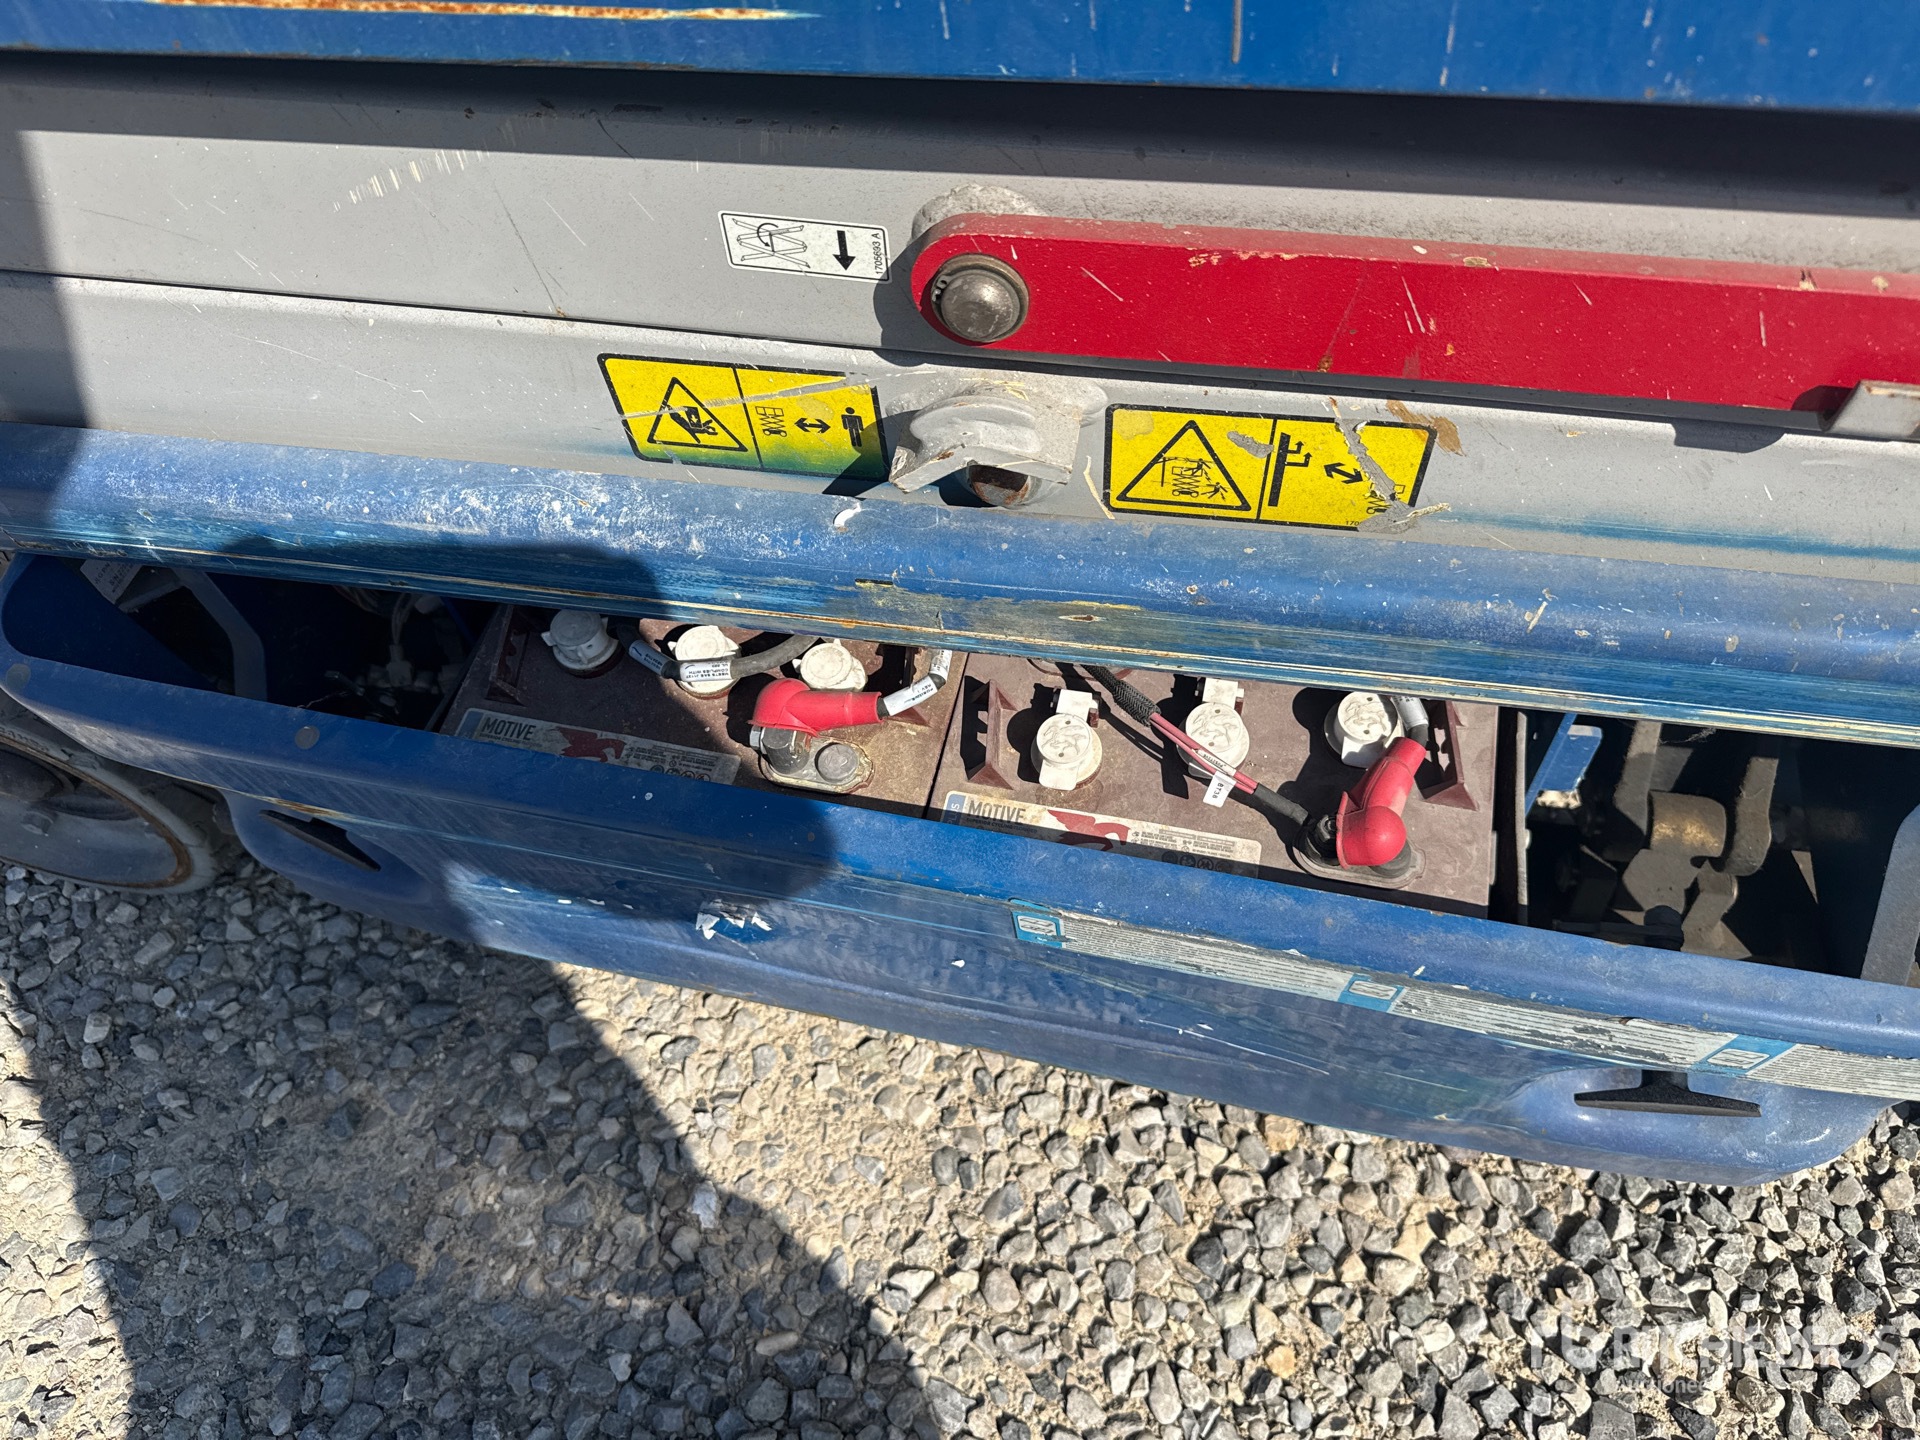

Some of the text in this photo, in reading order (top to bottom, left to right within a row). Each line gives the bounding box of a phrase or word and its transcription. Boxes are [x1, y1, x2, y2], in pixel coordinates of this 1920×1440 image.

[871, 232, 882, 240] A
[481, 717, 537, 741] MOTIVE
[967, 800, 1026, 825] MOTIVE
